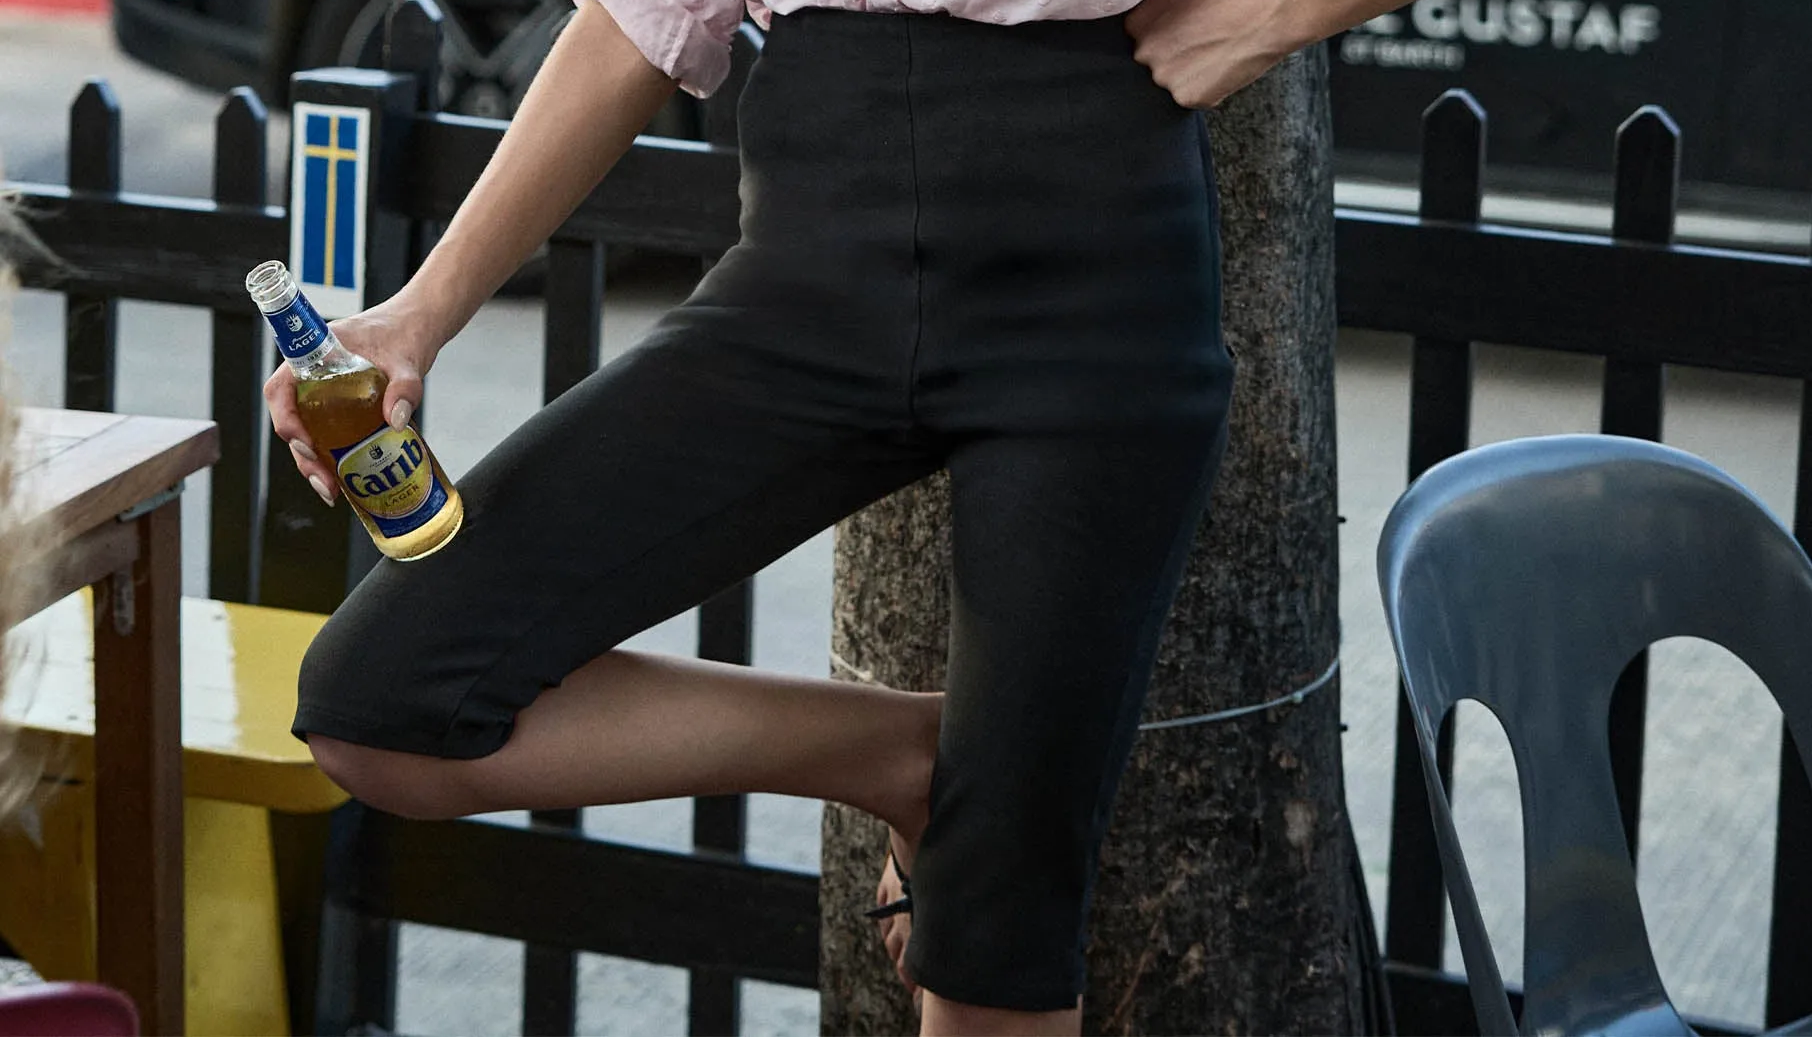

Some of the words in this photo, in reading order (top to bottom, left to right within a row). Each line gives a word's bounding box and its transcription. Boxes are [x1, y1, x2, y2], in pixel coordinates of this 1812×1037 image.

[288, 329, 321, 351] LAGER
[343, 438, 424, 499] Carib
[385, 483, 421, 507] LAGER
